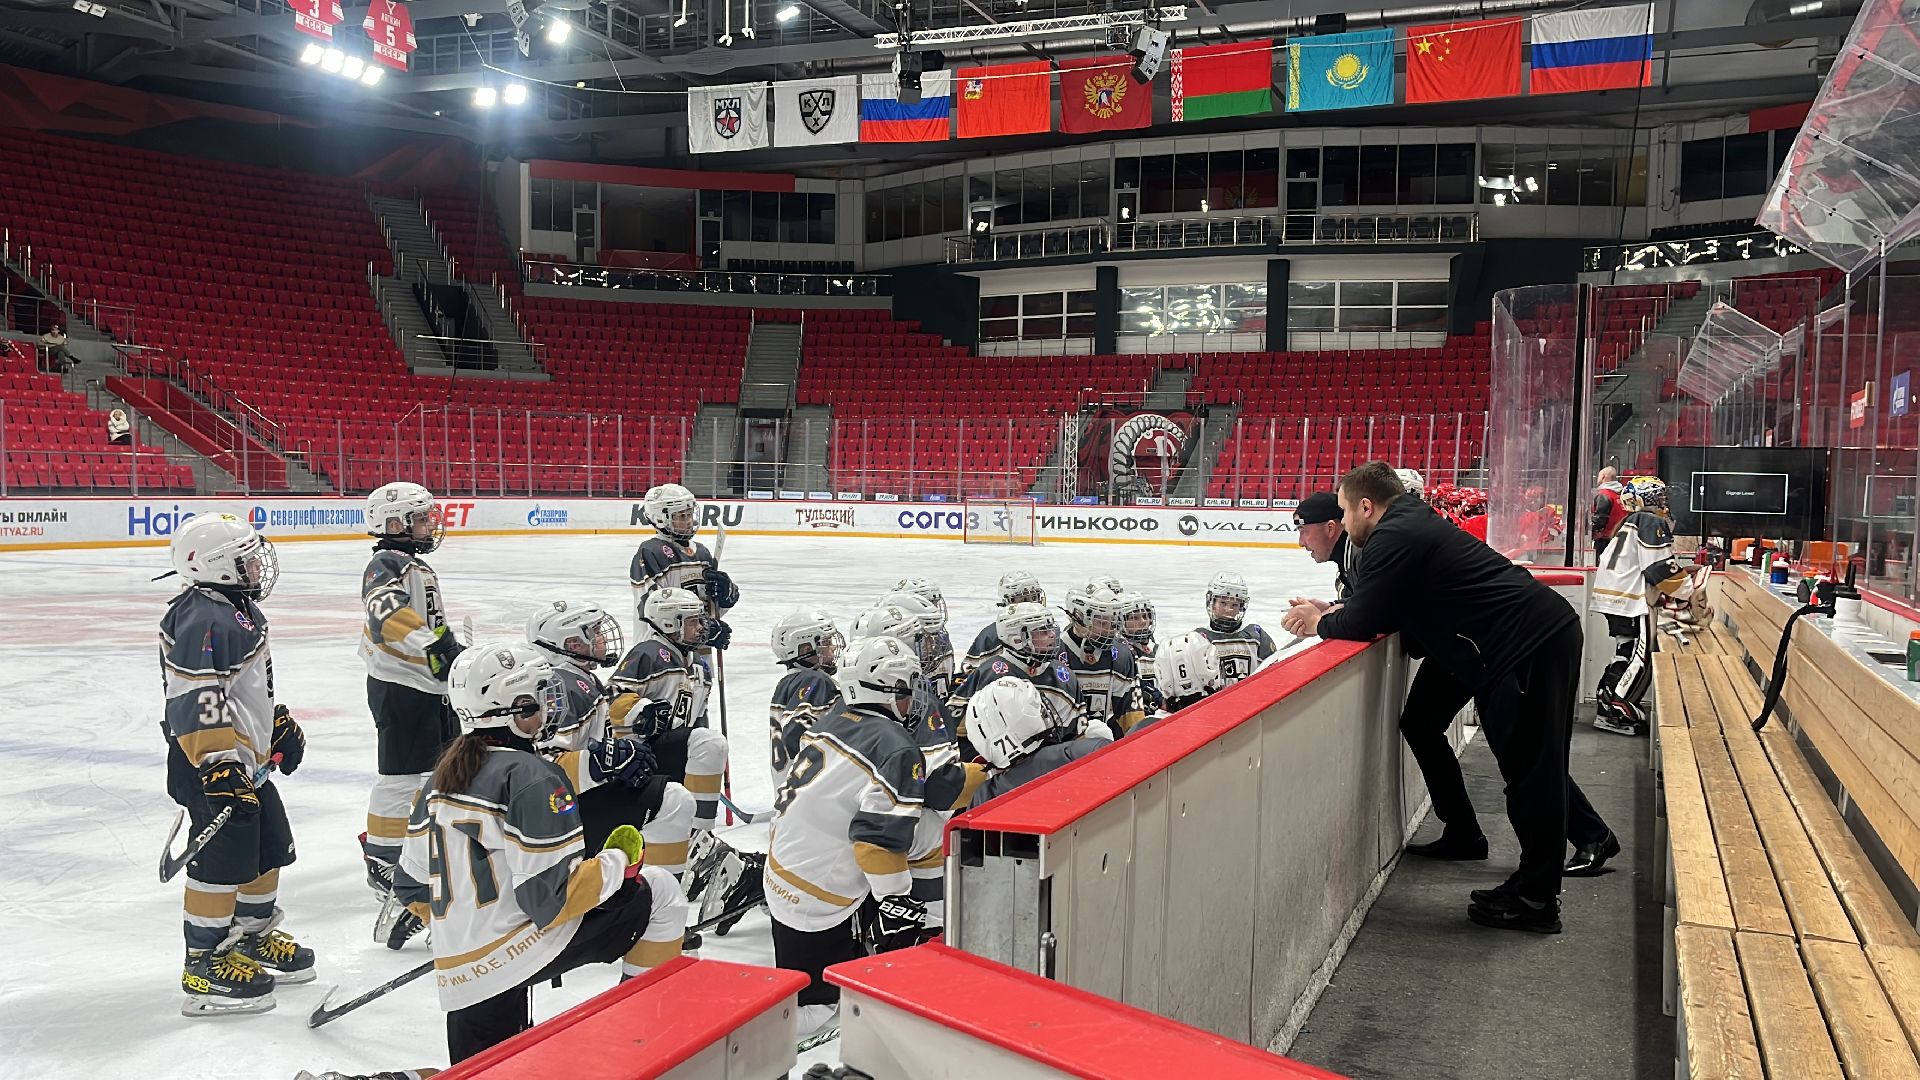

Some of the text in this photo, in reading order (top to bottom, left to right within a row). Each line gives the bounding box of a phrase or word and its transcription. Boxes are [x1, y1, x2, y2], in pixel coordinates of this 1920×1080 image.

[303, 17, 326, 33] СССР
[386, 25, 396, 46] 5
[380, 46, 401, 60] СССР
[715, 98, 740, 109] МХЛ
[18, 508, 67, 523] ОНЛАЙН
[540, 509, 568, 517] ГАЗПРОМ
[795, 506, 855, 528] ТУЛЬСКИЙ
[1027, 516, 1159, 532] ТИНЬКОФФ
[1178, 664, 1187, 679] 6
[993, 734, 1018, 756] 71
[449, 973, 472, 986] им.
[471, 957, 506, 978] Ю.Е.
